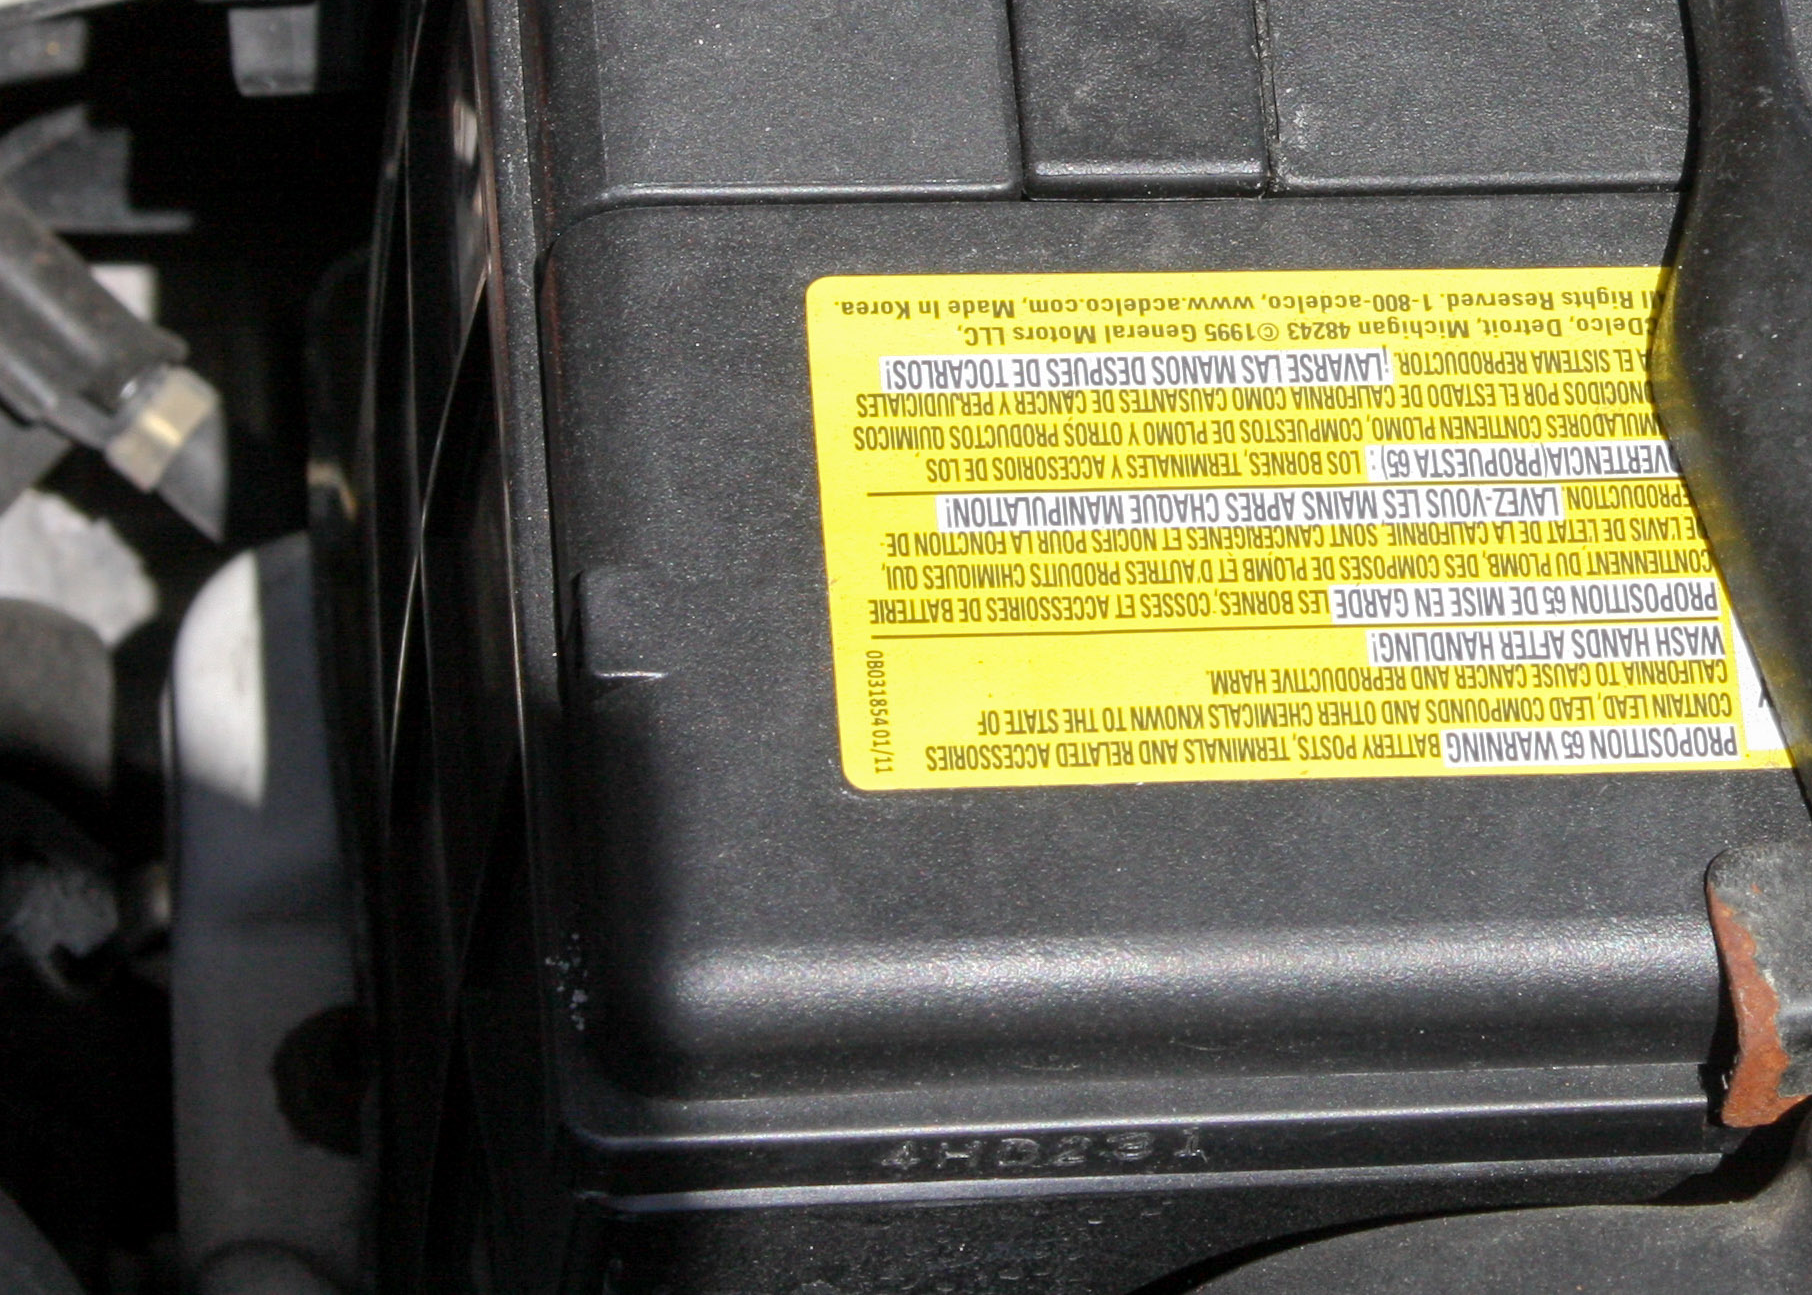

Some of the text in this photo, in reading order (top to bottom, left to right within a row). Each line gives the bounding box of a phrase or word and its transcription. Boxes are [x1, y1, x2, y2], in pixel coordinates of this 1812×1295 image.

[834, 287, 1633, 320] Rights Reserved. 1-800-acdelco, www.acdelco.com, Made In Korea.
[956, 325, 1005, 346] LLC,
[1012, 325, 1096, 344] Motors
[1104, 325, 1197, 344] General
[1287, 321, 1351, 340] 48243
[1358, 317, 1469, 339] Michigan
[1477, 318, 1561, 337] Detroit,
[1370, 626, 1725, 663] WASH HANDS AFTER HANDLING!
[926, 726, 1738, 771] PROPOSITION 65 WARNING BATTERY POSTS, TERMINALS AND RELATED ACCESSORIES
